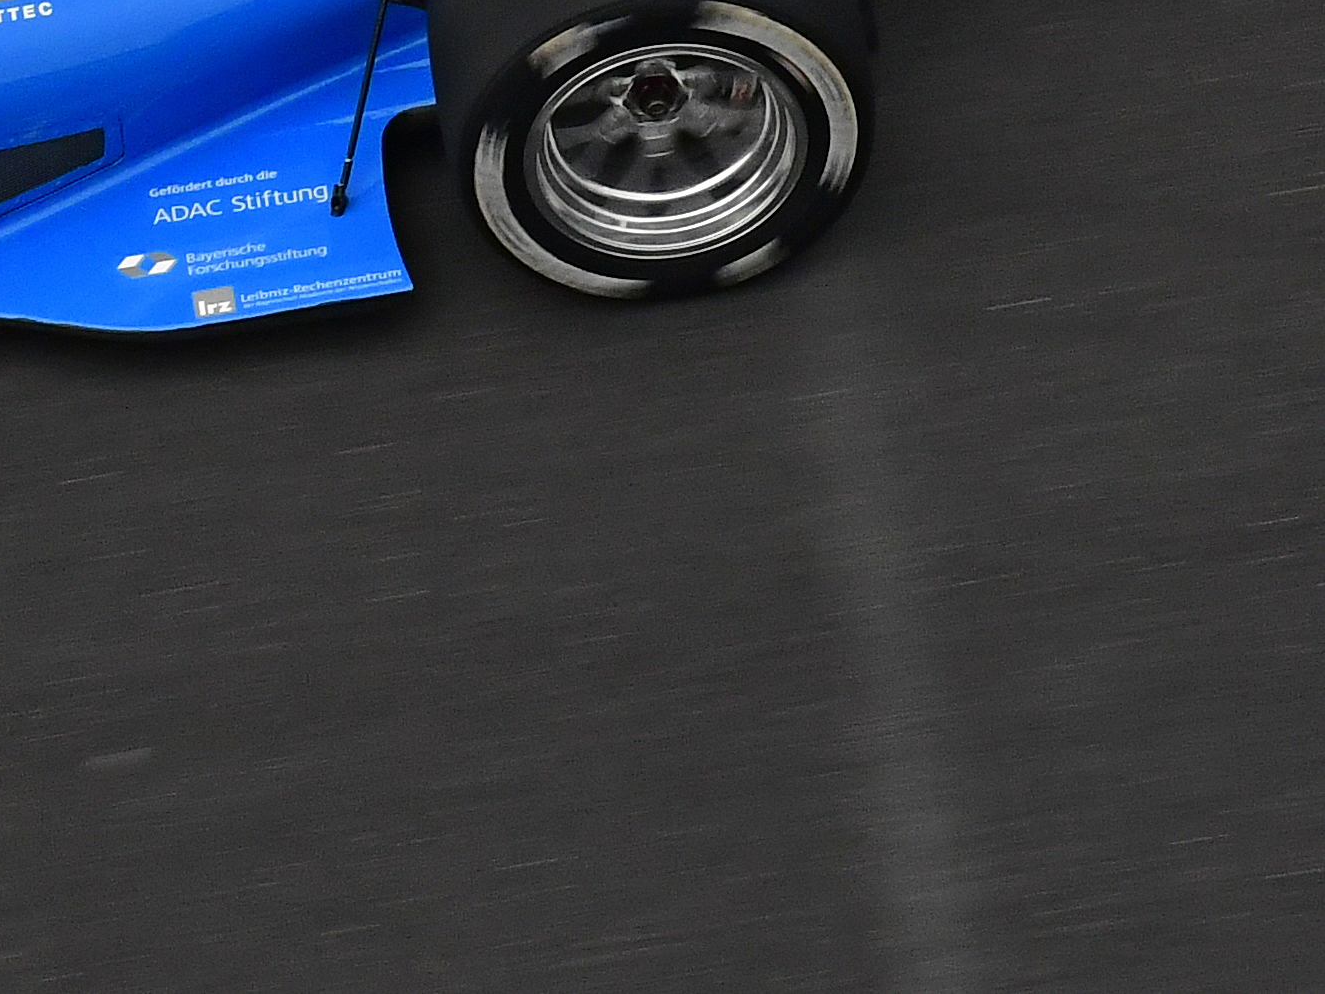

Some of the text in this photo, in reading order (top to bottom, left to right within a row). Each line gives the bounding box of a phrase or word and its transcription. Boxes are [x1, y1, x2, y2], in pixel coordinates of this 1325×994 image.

[149, 169, 277, 198] Gefördert durch die
[153, 184, 329, 225] ADAC Stiftung
[186, 242, 266, 263] Bayerische
[188, 245, 329, 276] Forschungsstiftung
[241, 269, 402, 303] Leibniz-Rechenzentrum
[197, 299, 233, 317] lrz
